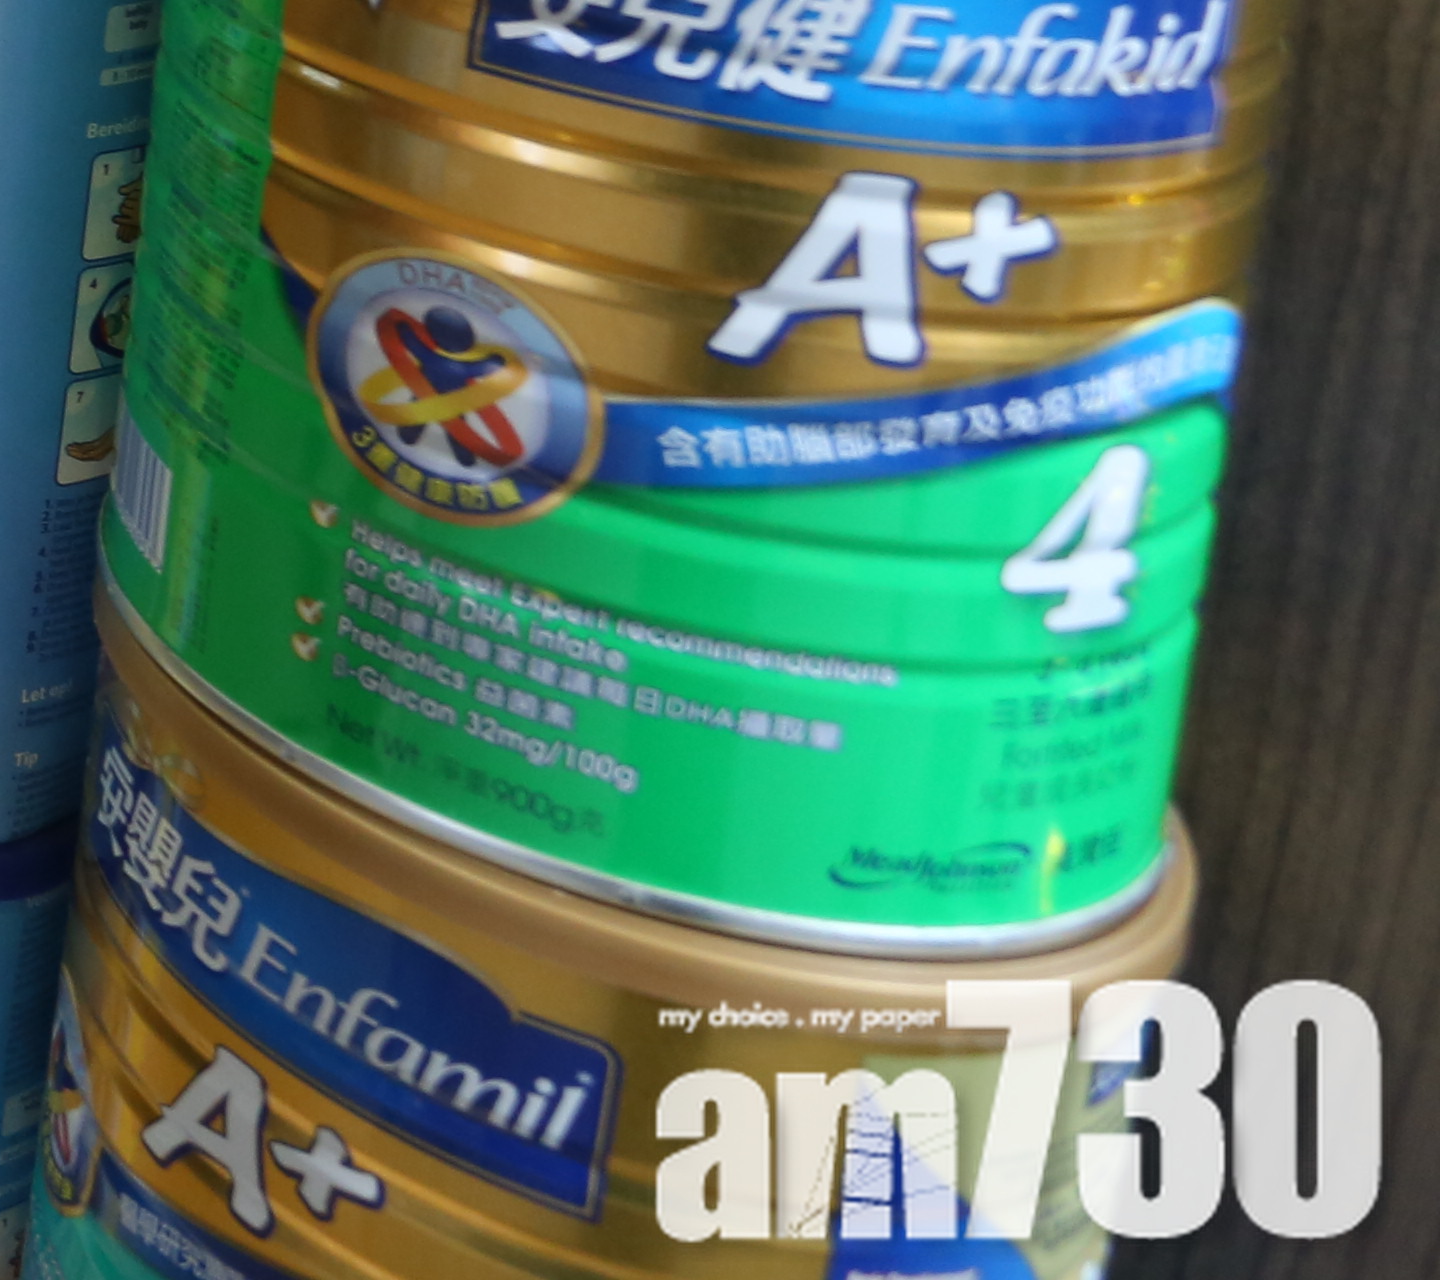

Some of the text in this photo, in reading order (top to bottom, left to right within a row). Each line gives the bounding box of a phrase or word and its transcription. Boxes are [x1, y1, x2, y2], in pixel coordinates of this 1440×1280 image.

[707, 169, 1061, 367] A+
[998, 440, 1151, 633] 4
[615, 614, 899, 687] recommendations
[236, 918, 597, 1157] Enfamil
[142, 1044, 386, 1237] A+
